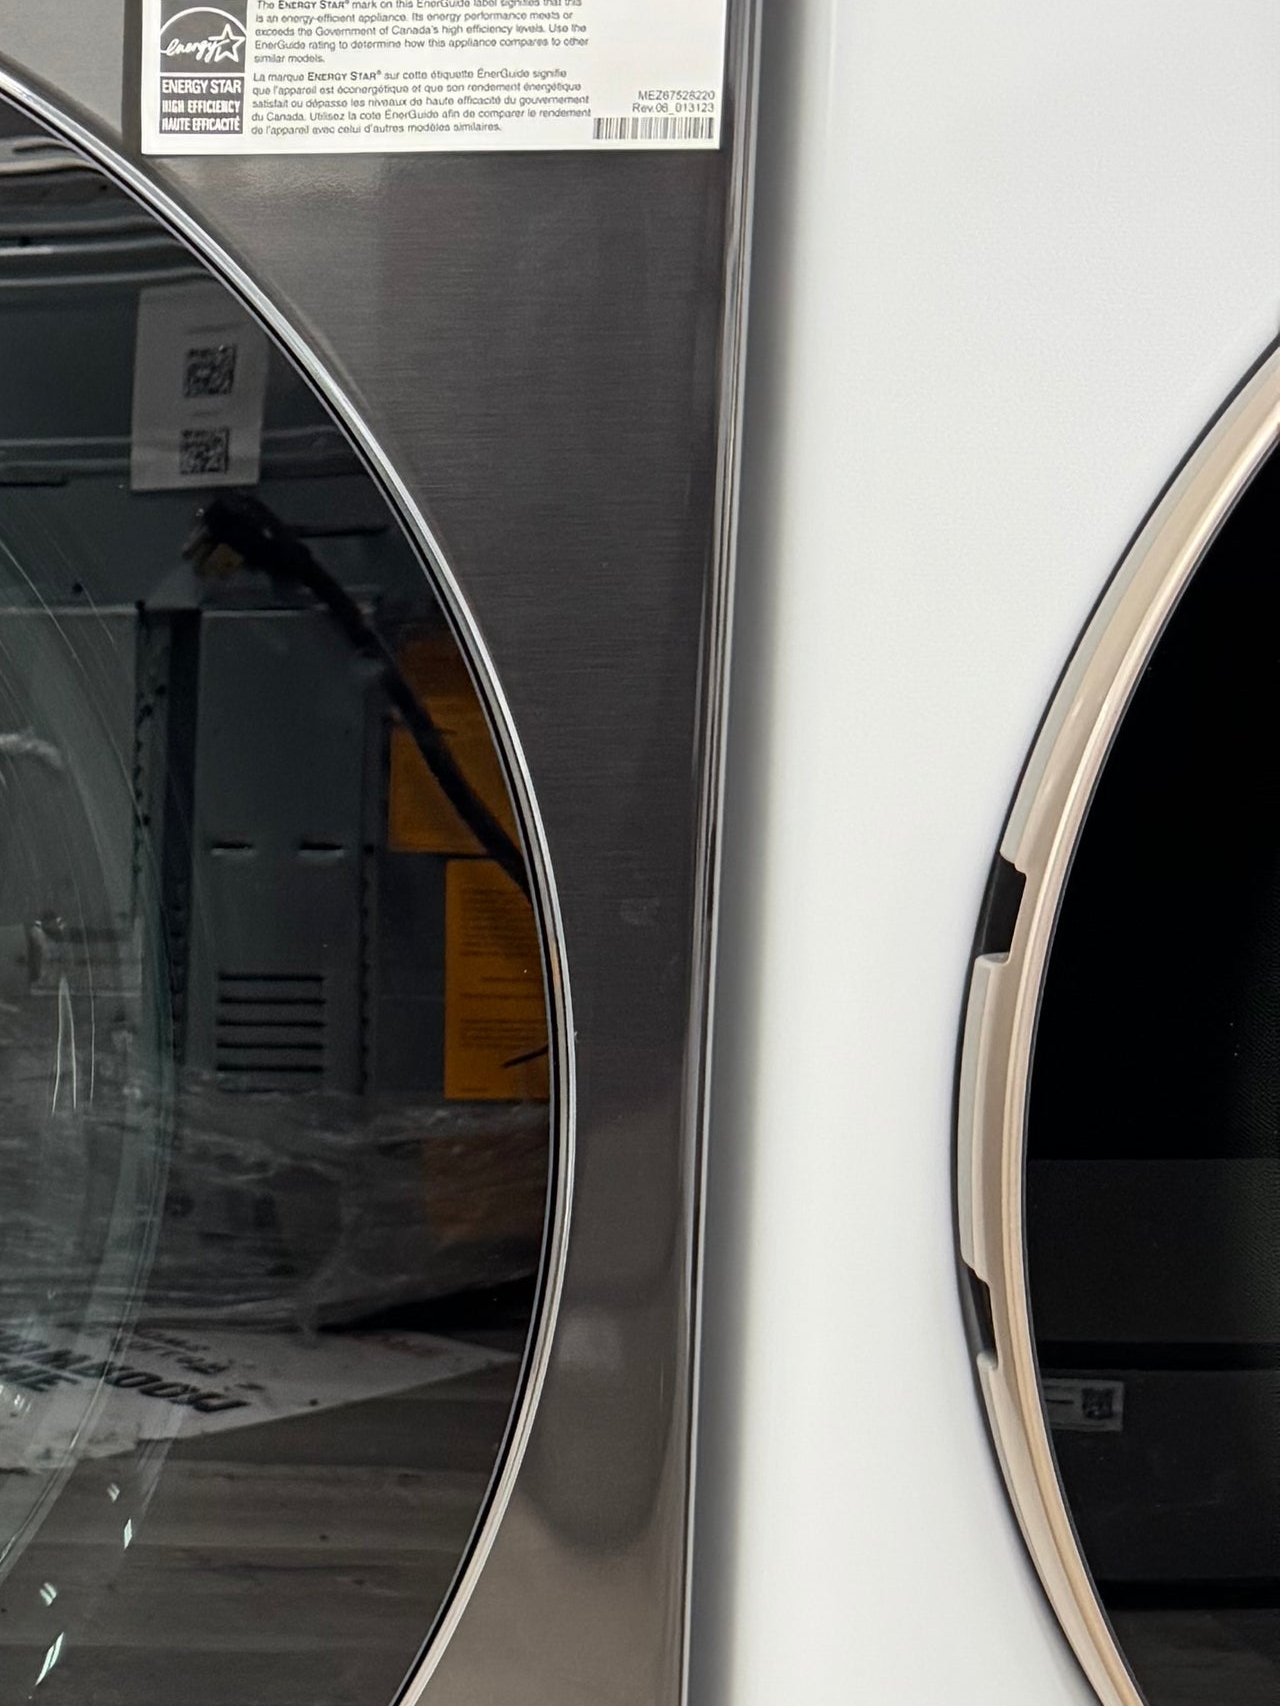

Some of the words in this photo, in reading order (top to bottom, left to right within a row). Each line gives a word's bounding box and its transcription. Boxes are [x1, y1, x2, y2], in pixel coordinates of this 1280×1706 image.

[257, 0, 274, 9] The
[278, 0, 317, 10] ENERGY
[352, 0, 377, 9] mark
[380, 1, 393, 9] on
[396, 0, 413, 8] this
[161, 79, 209, 94] ENERGY
[210, 79, 242, 94] STAR
[161, 99, 185, 114] HIGH
[187, 99, 241, 114] EFFICIENCY
[161, 117, 191, 132] HAUTE
